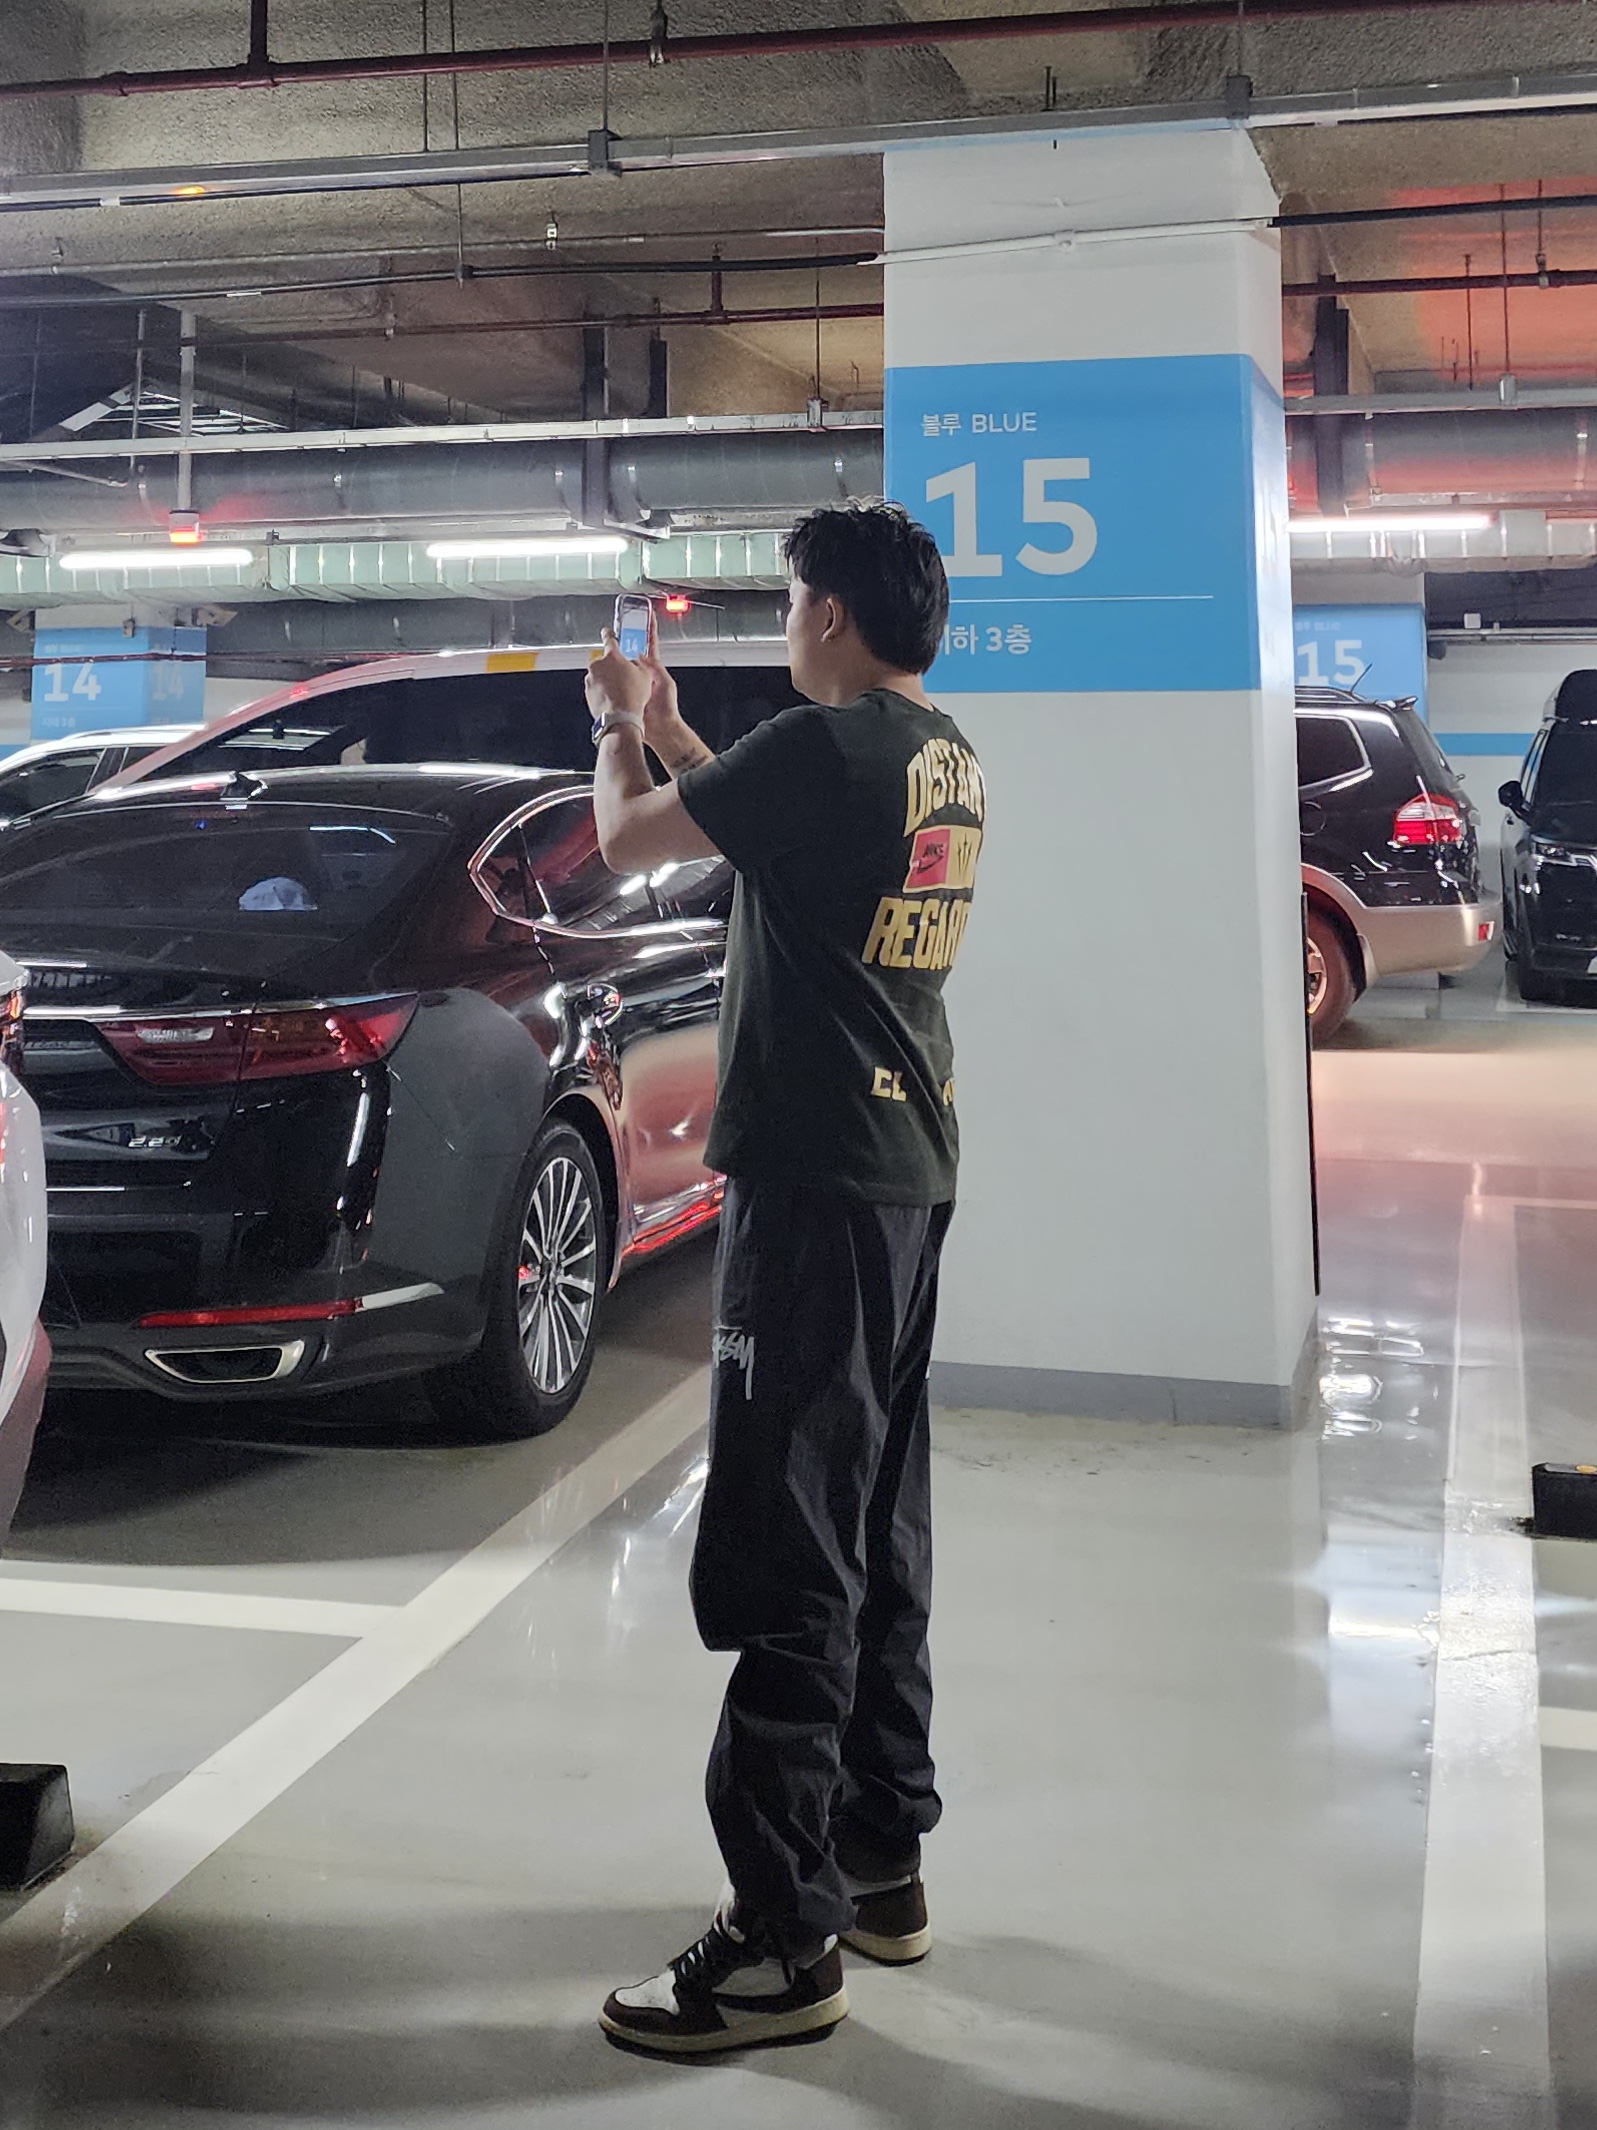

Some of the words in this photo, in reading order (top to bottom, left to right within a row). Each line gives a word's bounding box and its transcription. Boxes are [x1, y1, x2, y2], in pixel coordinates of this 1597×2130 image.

[921, 413, 962, 437] 블루
[971, 411, 1037, 433] BLUE
[925, 457, 1098, 577] 15
[985, 622, 1032, 655] 3층
[44, 662, 102, 702] 14
[1297, 639, 1366, 686] 15
[903, 738, 986, 837] DISTAN
